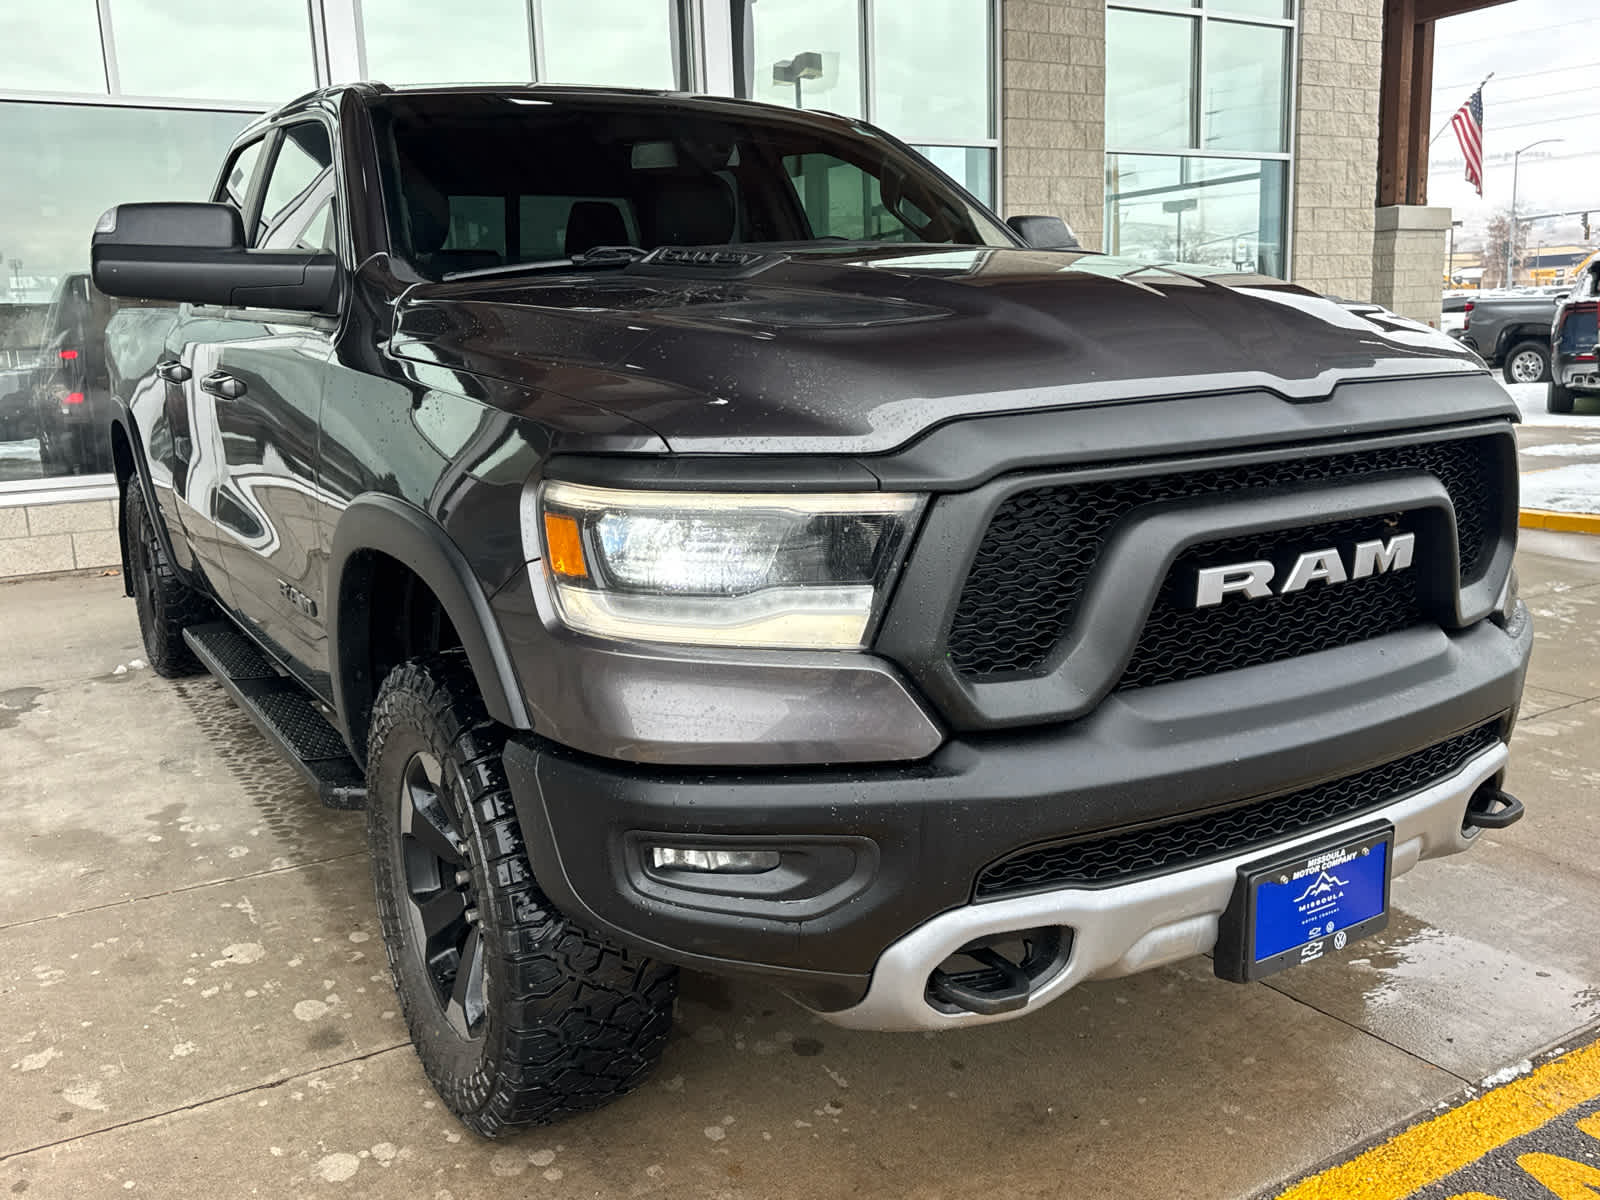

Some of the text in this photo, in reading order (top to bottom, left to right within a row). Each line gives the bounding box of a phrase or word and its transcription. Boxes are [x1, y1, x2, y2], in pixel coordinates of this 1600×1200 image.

[1196, 532, 1415, 608] RAM
[1292, 851, 1358, 880] MOTOR COMPANY
[1307, 848, 1346, 868] MISSOULA
[1298, 891, 1344, 912] MISSOULA
